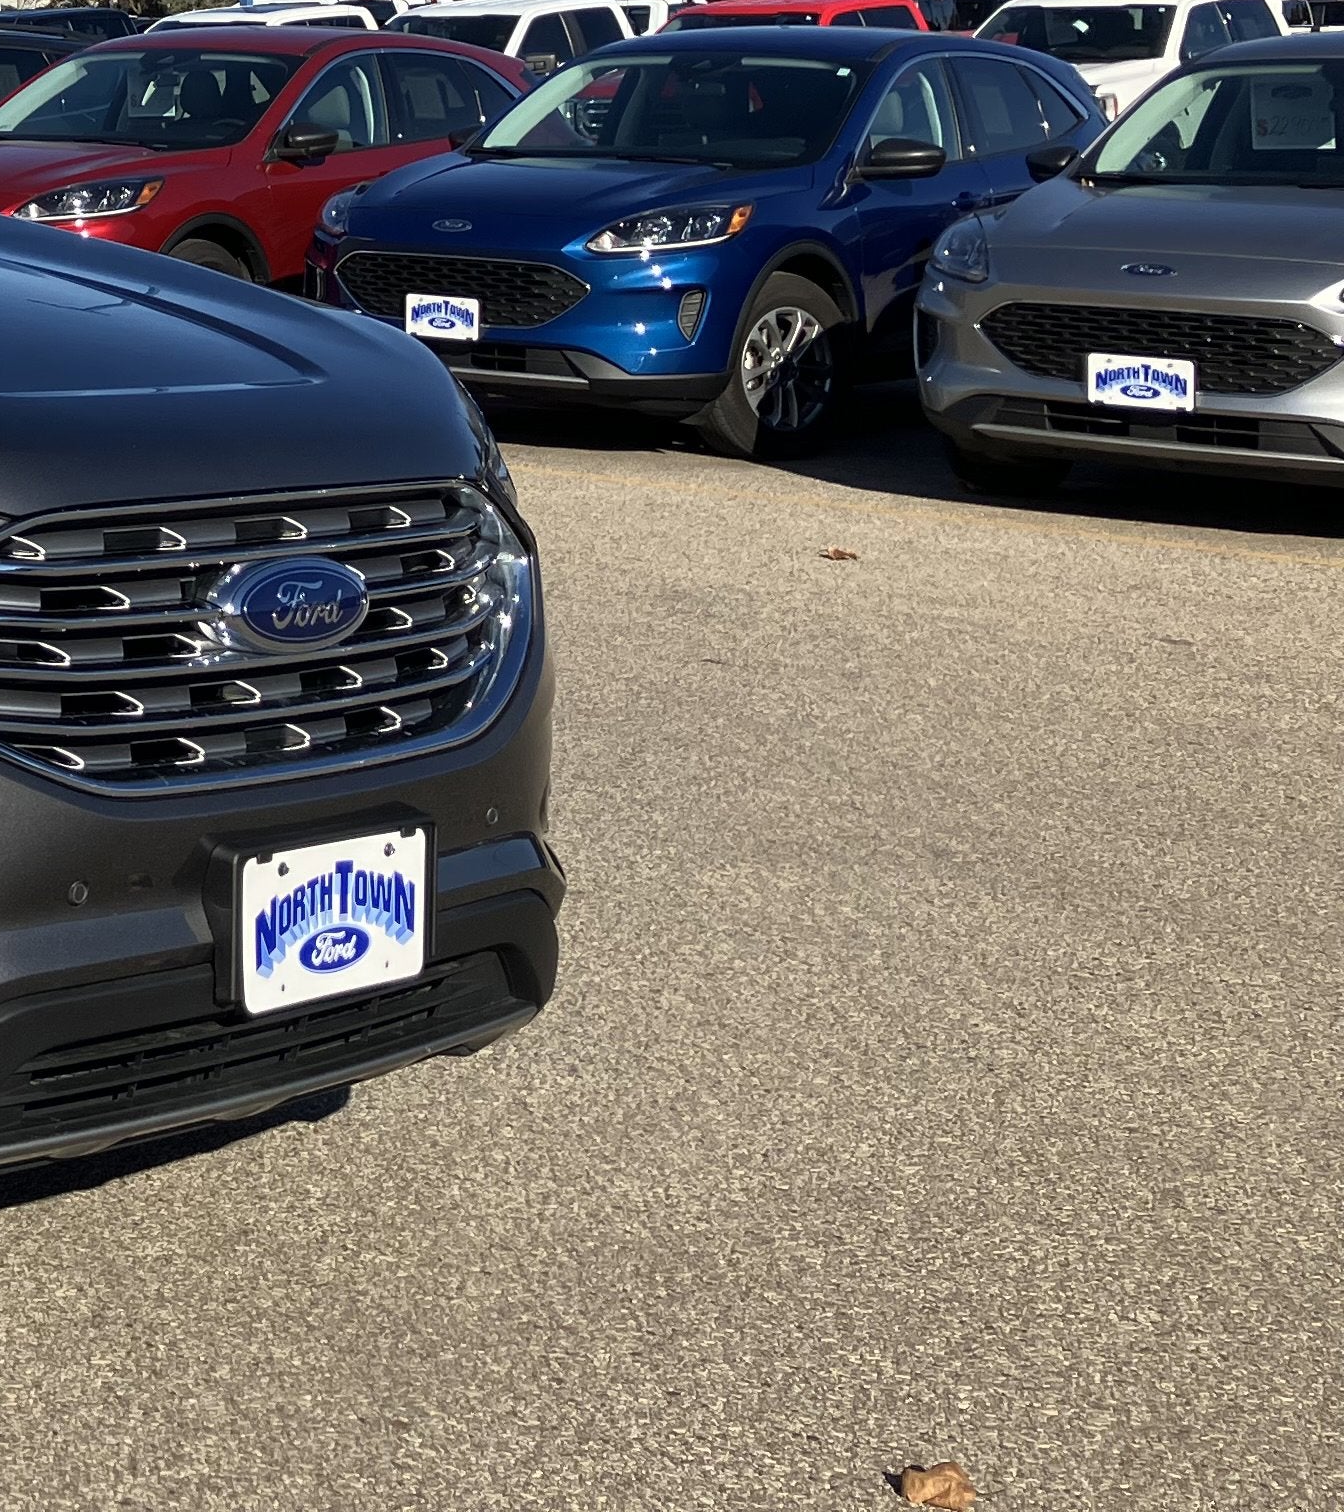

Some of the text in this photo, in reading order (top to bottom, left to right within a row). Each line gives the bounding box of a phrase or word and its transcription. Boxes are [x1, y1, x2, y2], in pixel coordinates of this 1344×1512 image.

[1127, 385, 1154, 398] Ford
[272, 580, 344, 630] Ford
[255, 859, 416, 975] NORTH TOWN
[311, 930, 357, 967] Ford
